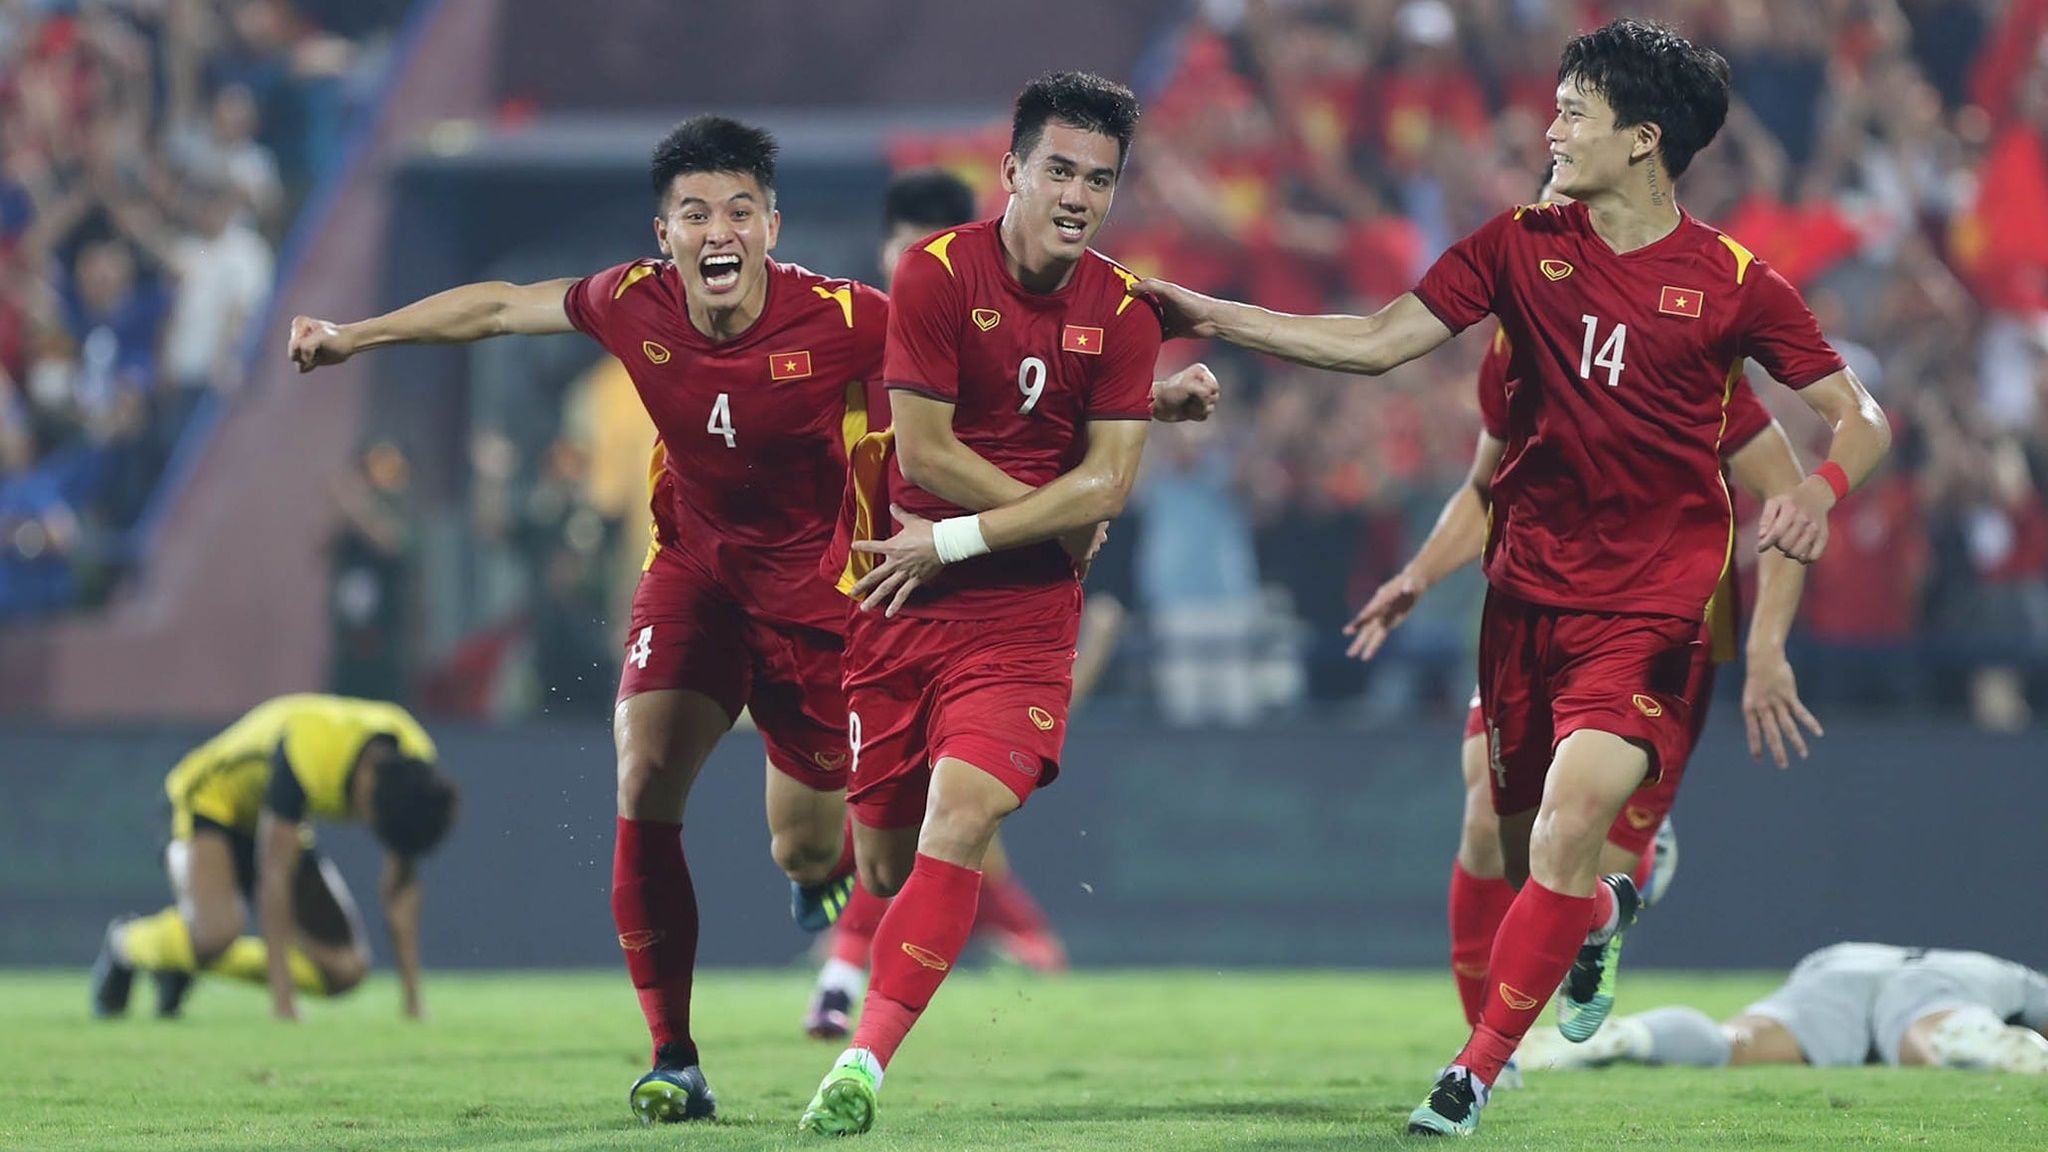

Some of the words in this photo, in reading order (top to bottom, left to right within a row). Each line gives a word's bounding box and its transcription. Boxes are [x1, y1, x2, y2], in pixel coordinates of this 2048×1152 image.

[1580, 314, 1627, 387] 14
[1018, 356, 1046, 414] 9
[707, 393, 737, 448] 4
[629, 624, 654, 669] 4
[849, 711, 861, 773] 9
